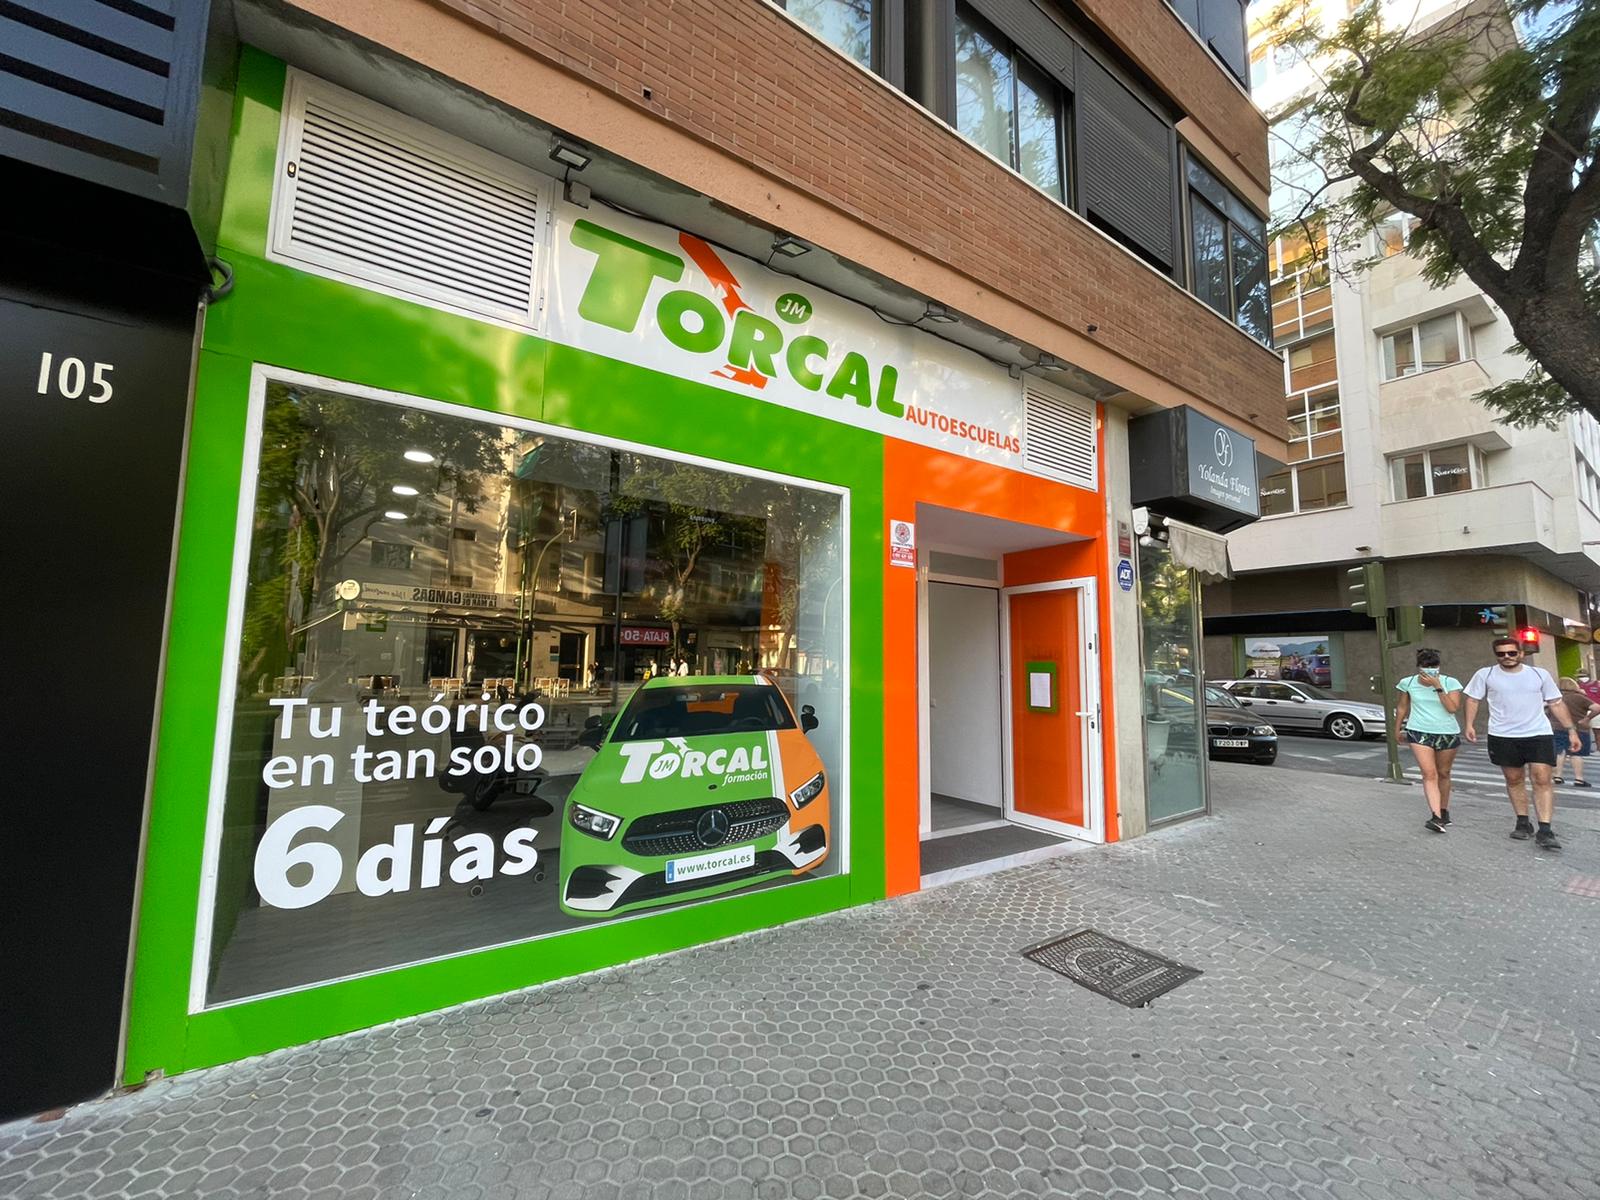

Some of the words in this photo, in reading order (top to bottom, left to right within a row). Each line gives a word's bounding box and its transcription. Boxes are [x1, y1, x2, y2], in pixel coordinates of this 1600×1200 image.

[570, 218, 905, 419] TORCAL
[781, 298, 807, 319] JM
[37, 352, 114, 404] 105
[905, 404, 1021, 455] AUTOESCUELAS
[1198, 464, 1229, 488] Yolanda
[1230, 477, 1250, 497] Flores
[269, 698, 342, 739] Tu
[363, 692, 545, 737] teórico
[262, 752, 335, 789] en
[350, 744, 436, 783] tan
[448, 734, 543, 776] solo
[619, 741, 768, 784] TORCAL
[653, 756, 676, 773] JM
[722, 770, 768, 787] formación
[253, 805, 346, 909] 6
[356, 816, 539, 897] días
[676, 854, 752, 876] www.torcal.es
